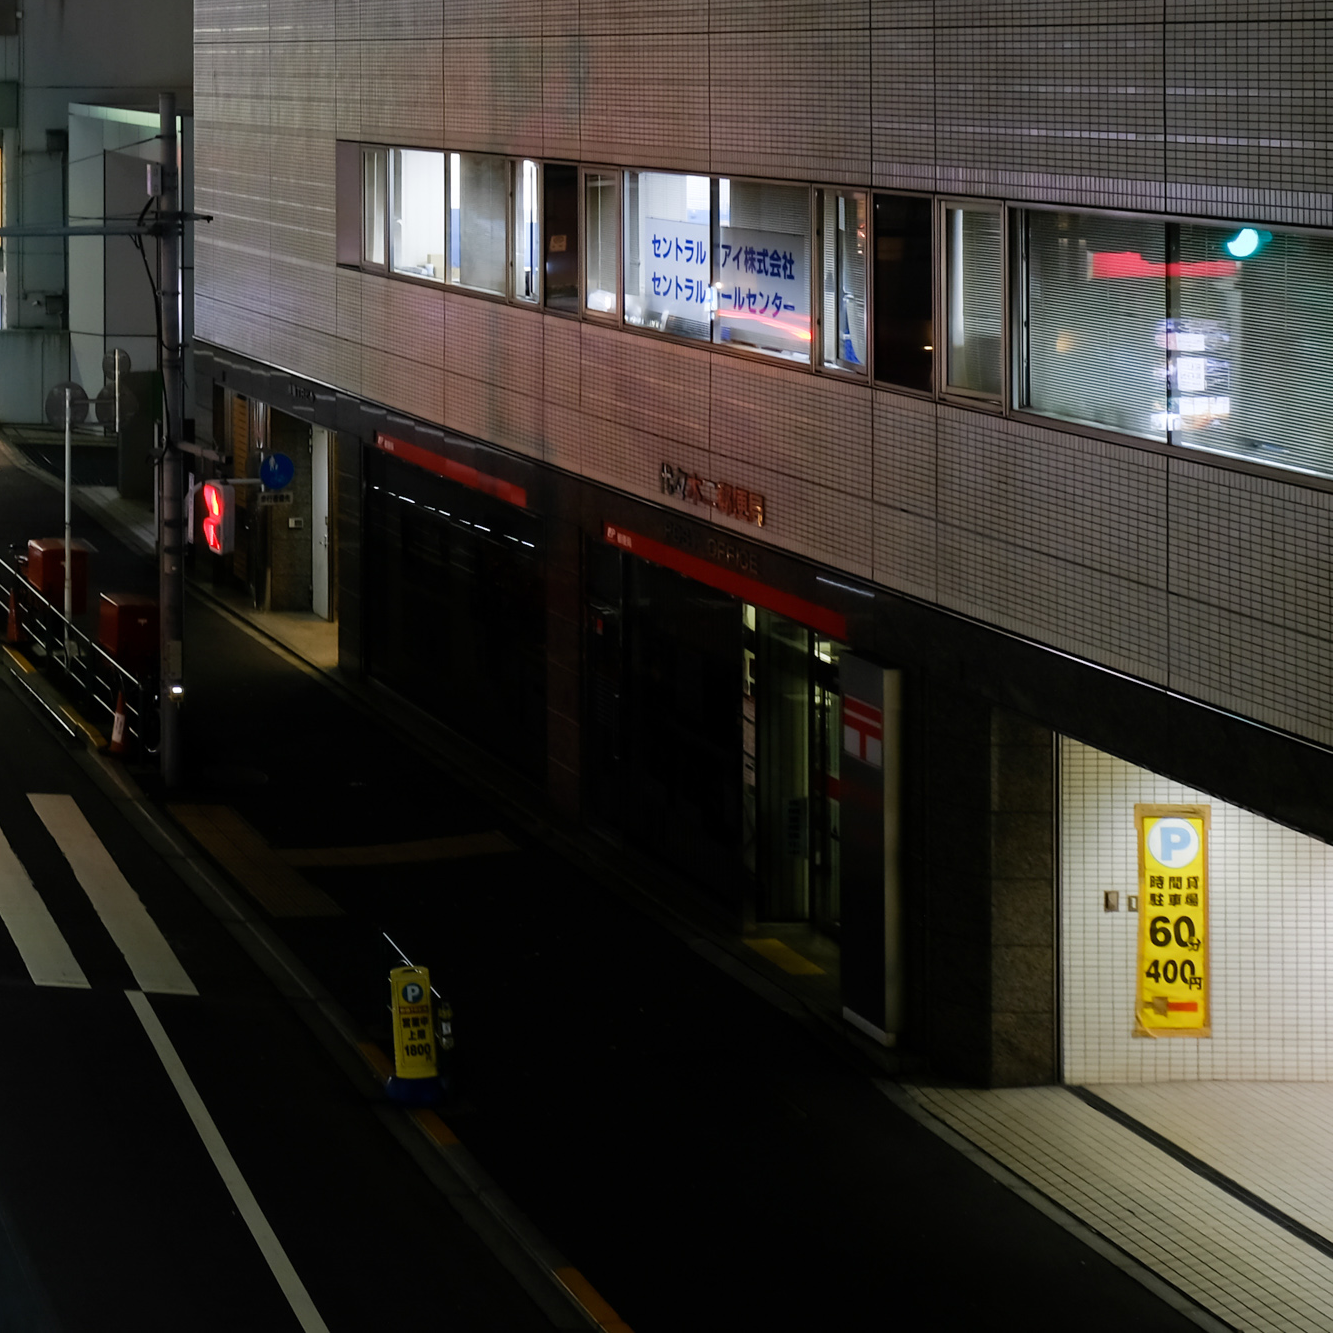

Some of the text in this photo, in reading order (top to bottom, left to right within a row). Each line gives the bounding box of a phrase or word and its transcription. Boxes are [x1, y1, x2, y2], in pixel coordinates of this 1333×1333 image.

[652, 272, 795, 318] セントラルールセンター
[1159, 827, 1191, 861] P
[1149, 875, 1199, 890] 時間貸
[1148, 892, 1199, 907] 駐車場
[1148, 916, 1201, 952] 60分
[1145, 959, 1203, 990] 400円
[406, 985, 420, 1003] P
